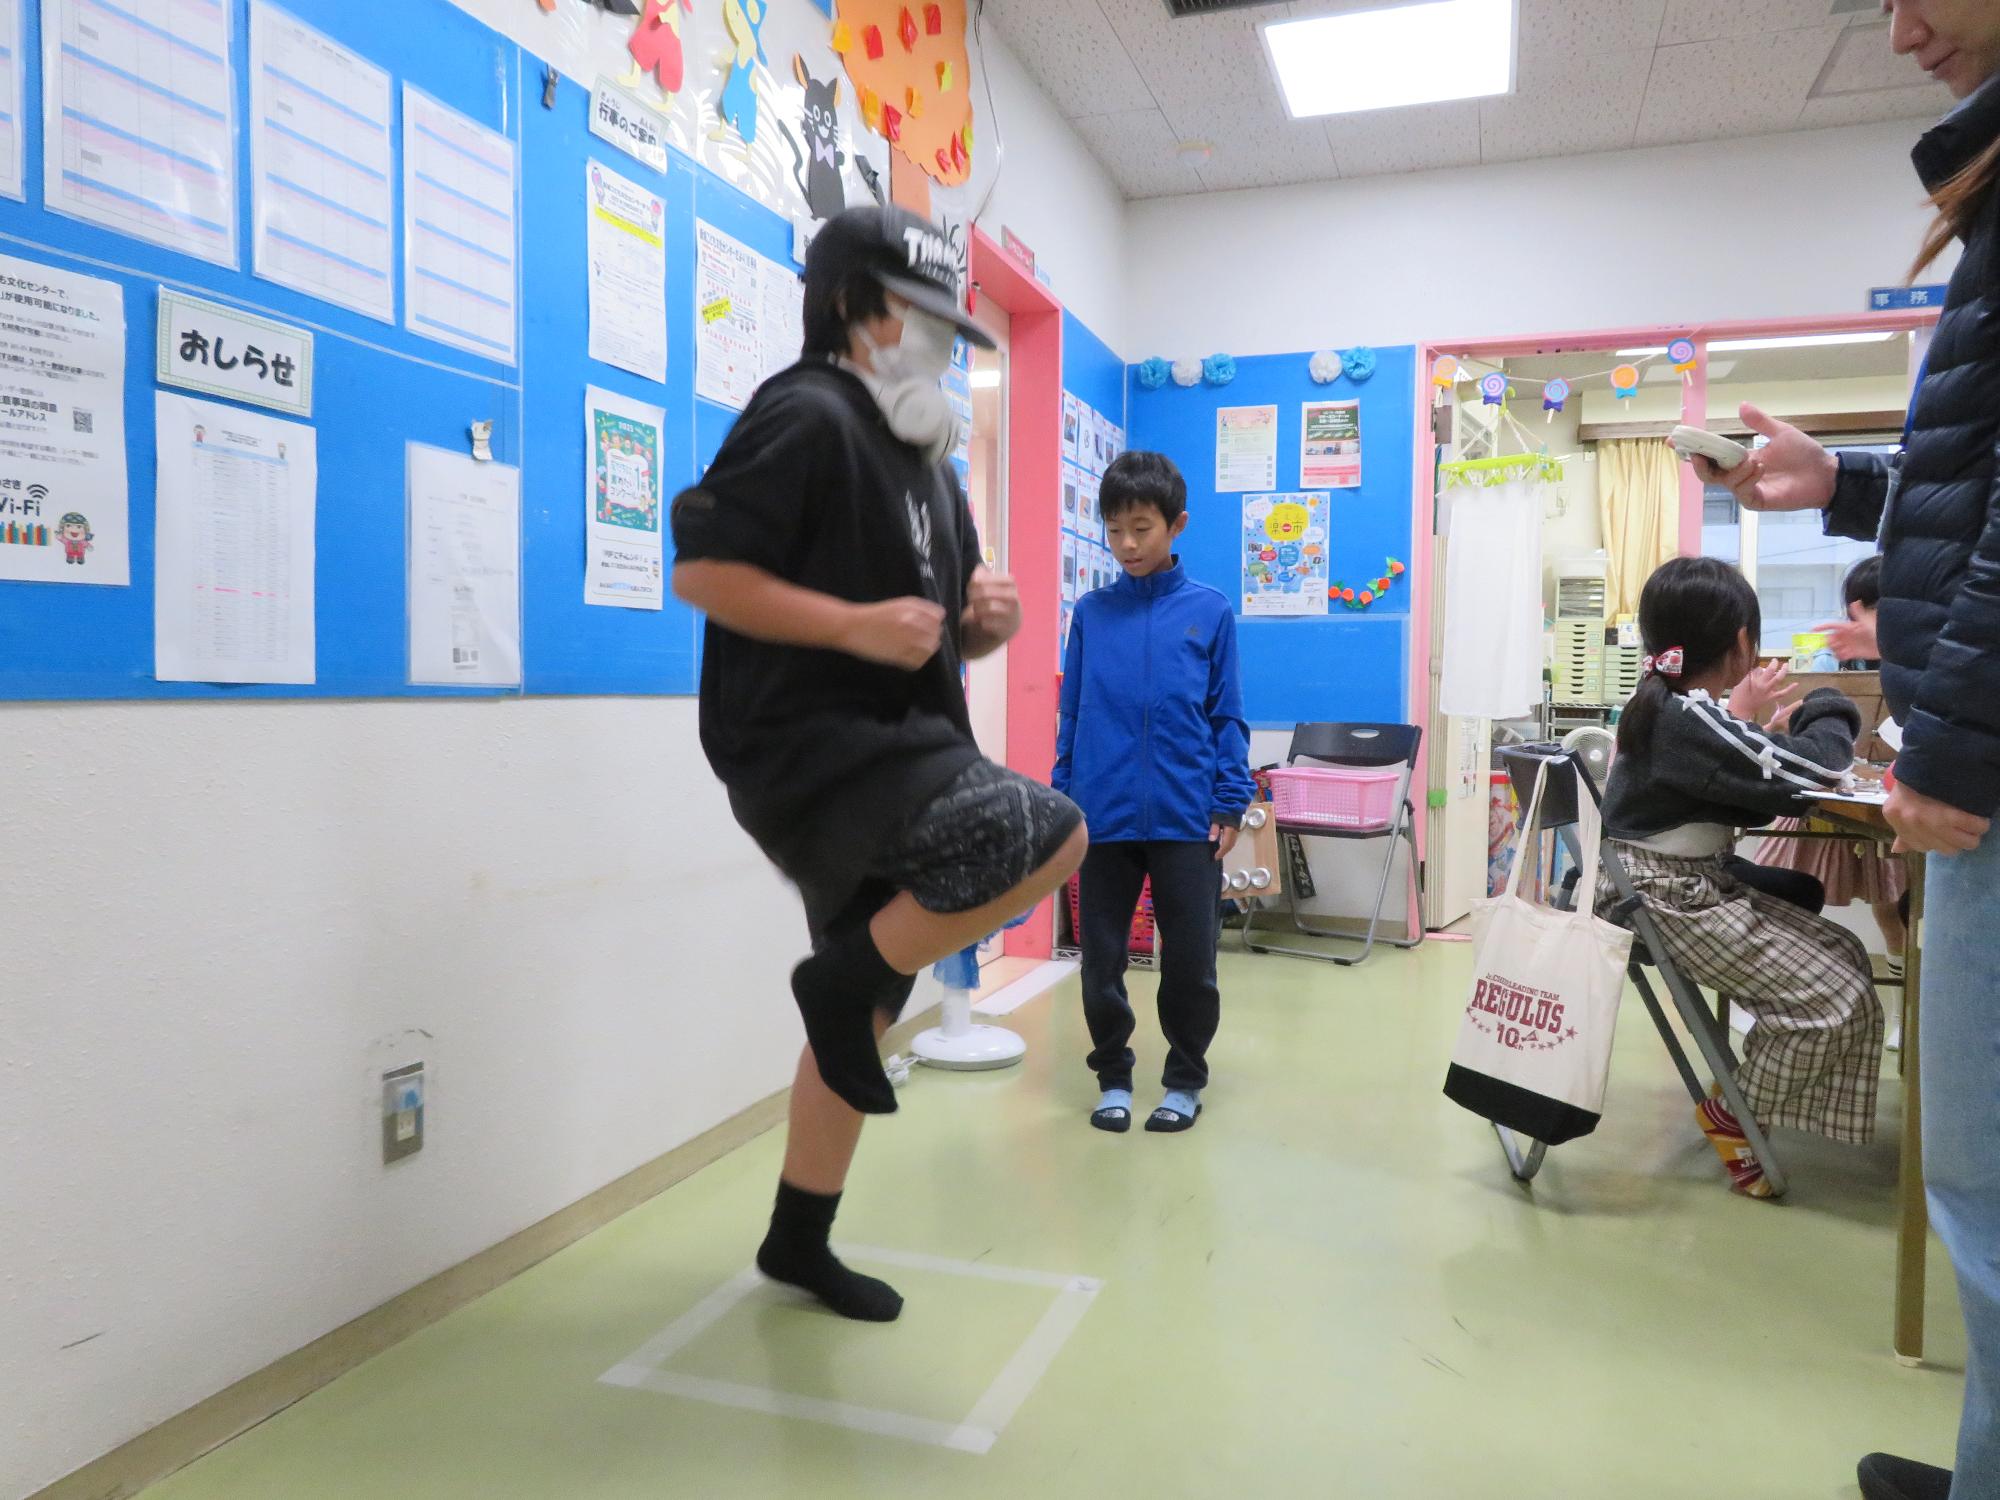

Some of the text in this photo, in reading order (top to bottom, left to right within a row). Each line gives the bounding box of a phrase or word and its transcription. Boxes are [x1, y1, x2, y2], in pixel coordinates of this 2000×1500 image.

[179, 329, 296, 387] おしらせ
[0, 478, 21, 490] さき
